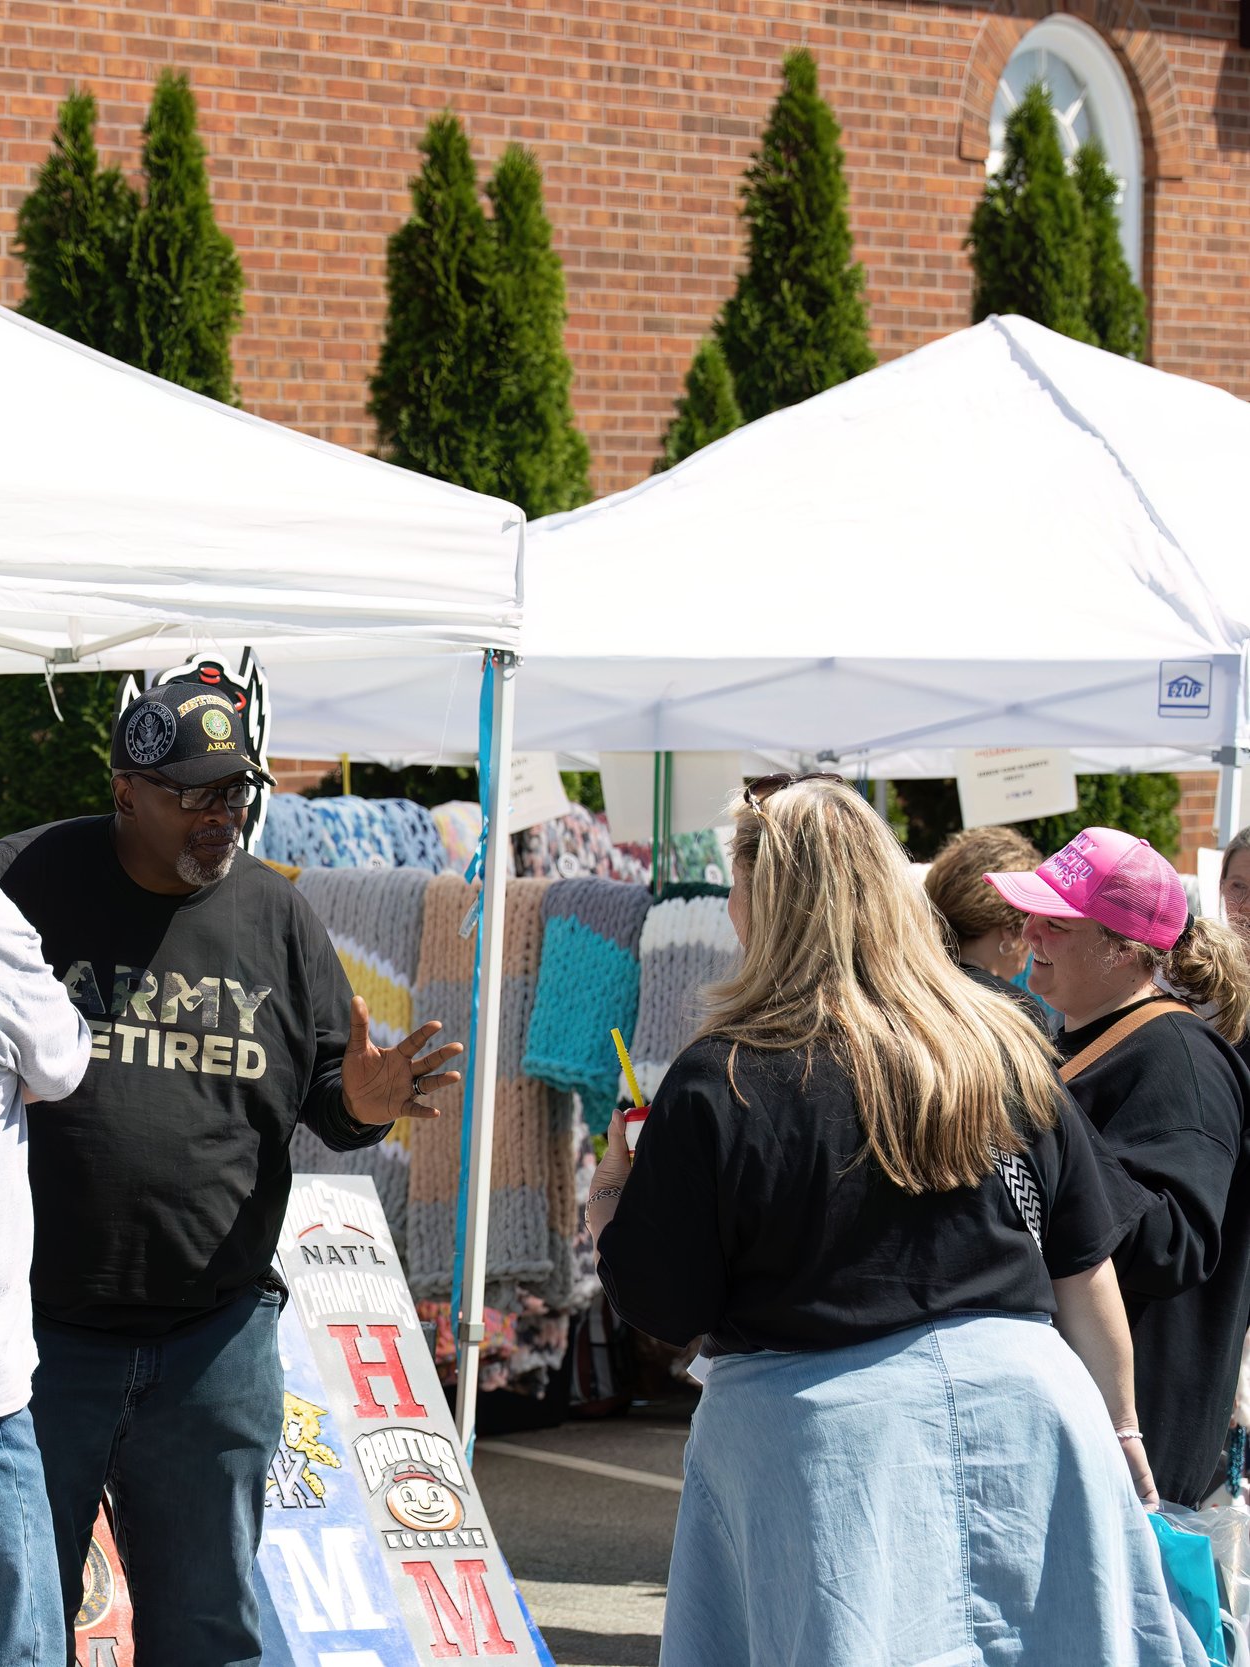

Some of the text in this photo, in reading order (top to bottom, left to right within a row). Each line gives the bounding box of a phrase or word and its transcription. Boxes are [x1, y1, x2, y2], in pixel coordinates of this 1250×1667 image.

[207, 742, 236, 752] ARMY
[60, 960, 273, 1034] ARMY
[87, 1019, 267, 1080] ETIRED
[300, 1245, 386, 1265] NAT'L
[293, 1271, 418, 1330] CHAMPIONS
[327, 1323, 429, 1419] H
[354, 1430, 466, 1492] BRUTUS
[384, 1531, 486, 1549] BUCKEYE
[266, 1526, 390, 1632] M
[401, 1559, 518, 1657] M
